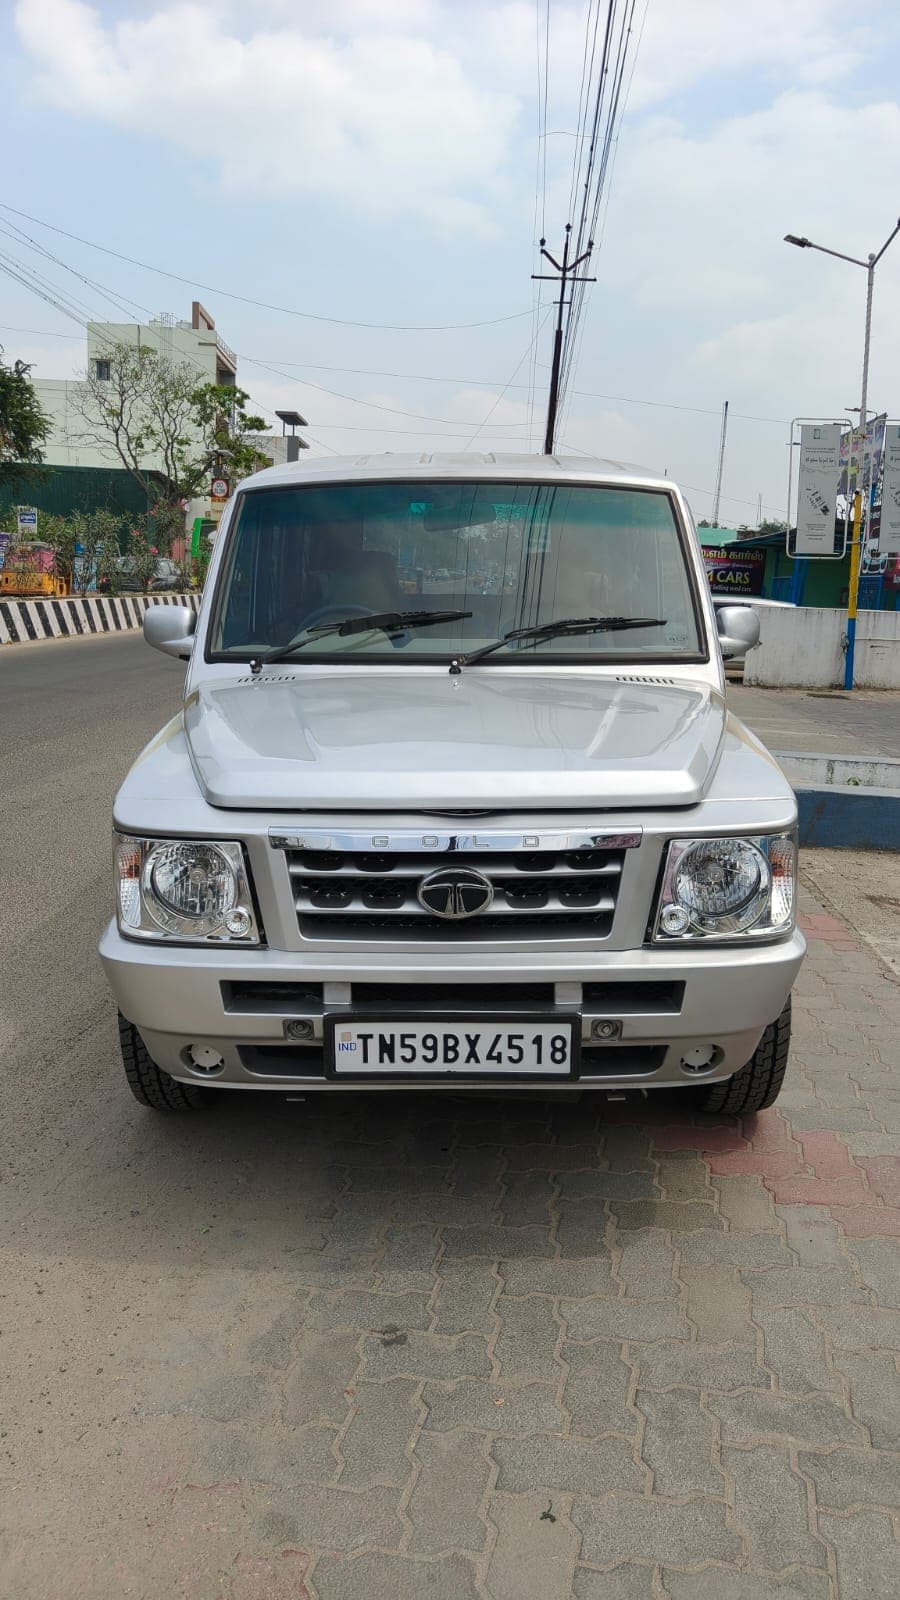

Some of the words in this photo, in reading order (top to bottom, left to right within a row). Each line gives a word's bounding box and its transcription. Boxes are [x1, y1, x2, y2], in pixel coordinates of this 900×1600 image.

[716, 570, 750, 584] CARS
[371, 835, 540, 848] GOLD
[338, 1042, 357, 1051] IND
[356, 1033, 568, 1065] TN59BX4518
